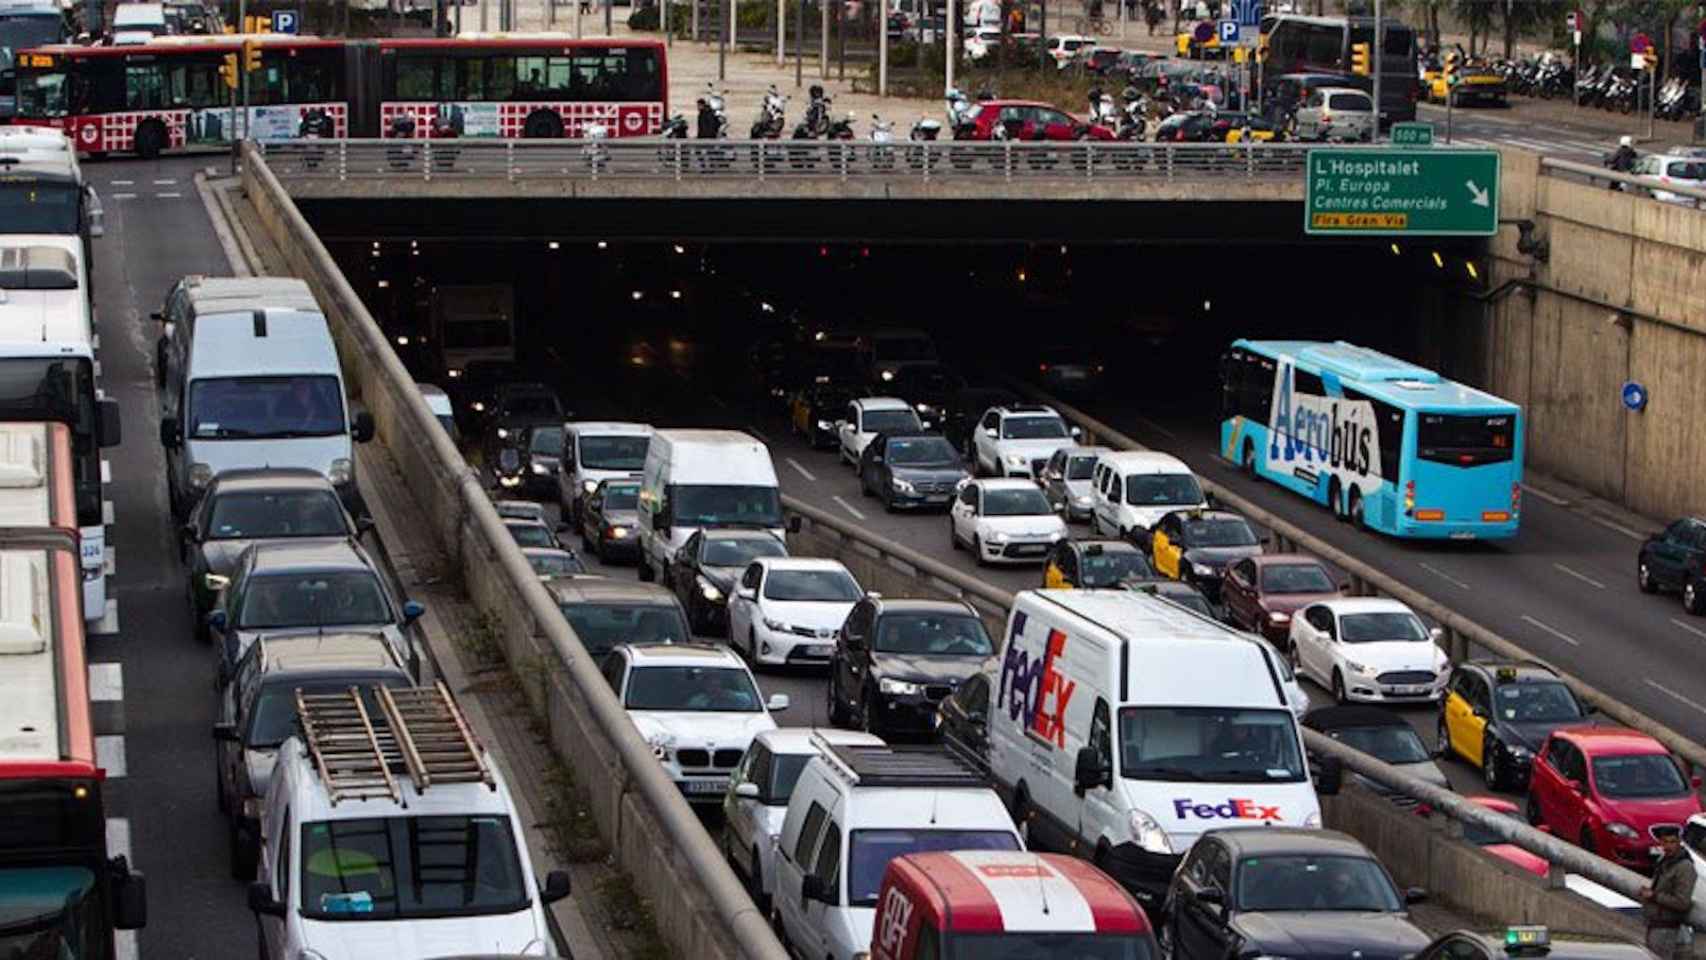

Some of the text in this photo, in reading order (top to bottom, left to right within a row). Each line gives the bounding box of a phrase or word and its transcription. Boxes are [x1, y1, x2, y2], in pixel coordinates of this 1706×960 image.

[278, 14, 294, 31] P
[1222, 22, 1236, 40] P
[1395, 130, 1430, 141] 500 m
[1315, 159, 1420, 177] L'Hospitalet
[1340, 178, 1390, 194] Europa
[1315, 196, 1448, 210] Centres Comercials
[1314, 214, 1405, 225] Fira Gran Via
[1271, 363, 1371, 477] Aerobús
[998, 610, 1076, 751] FedEx
[1173, 798, 1284, 820] FedEx
